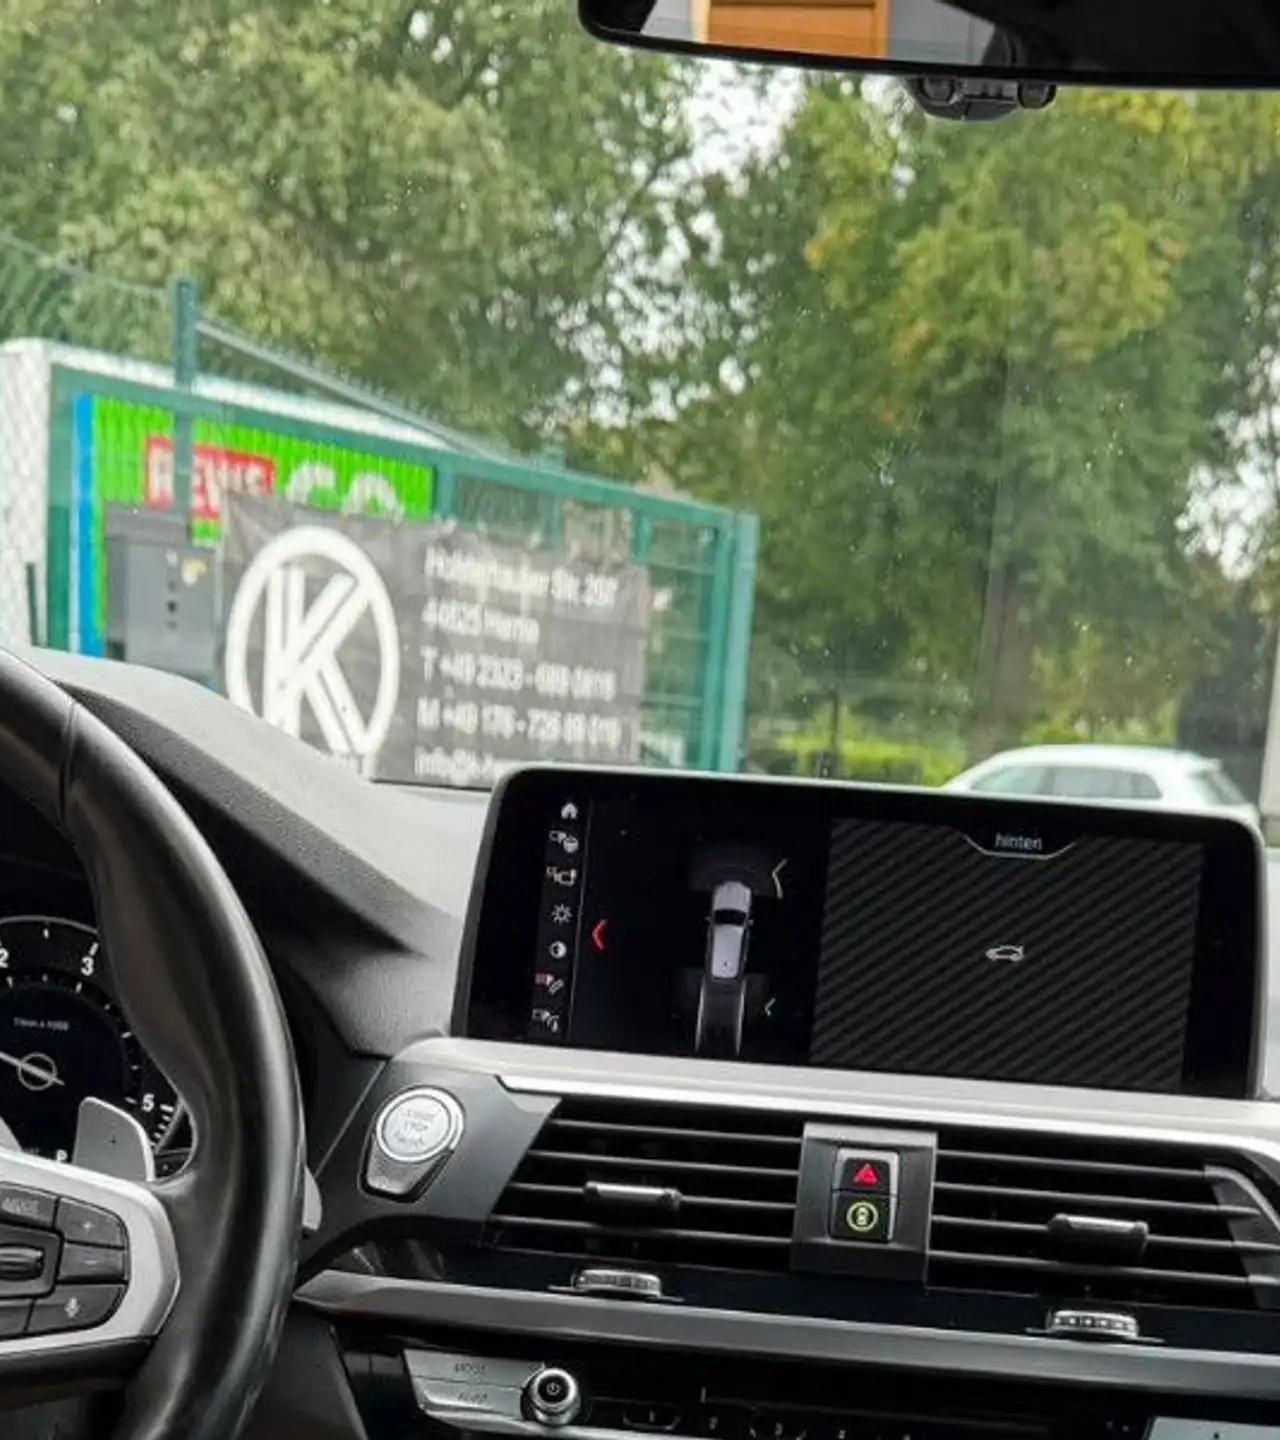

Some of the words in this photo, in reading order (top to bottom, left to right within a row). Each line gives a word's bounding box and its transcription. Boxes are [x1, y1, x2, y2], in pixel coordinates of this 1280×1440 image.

[995, 832, 1043, 850] hinten
[80, 955, 94, 976] 3
[140, 1093, 154, 1112] 5
